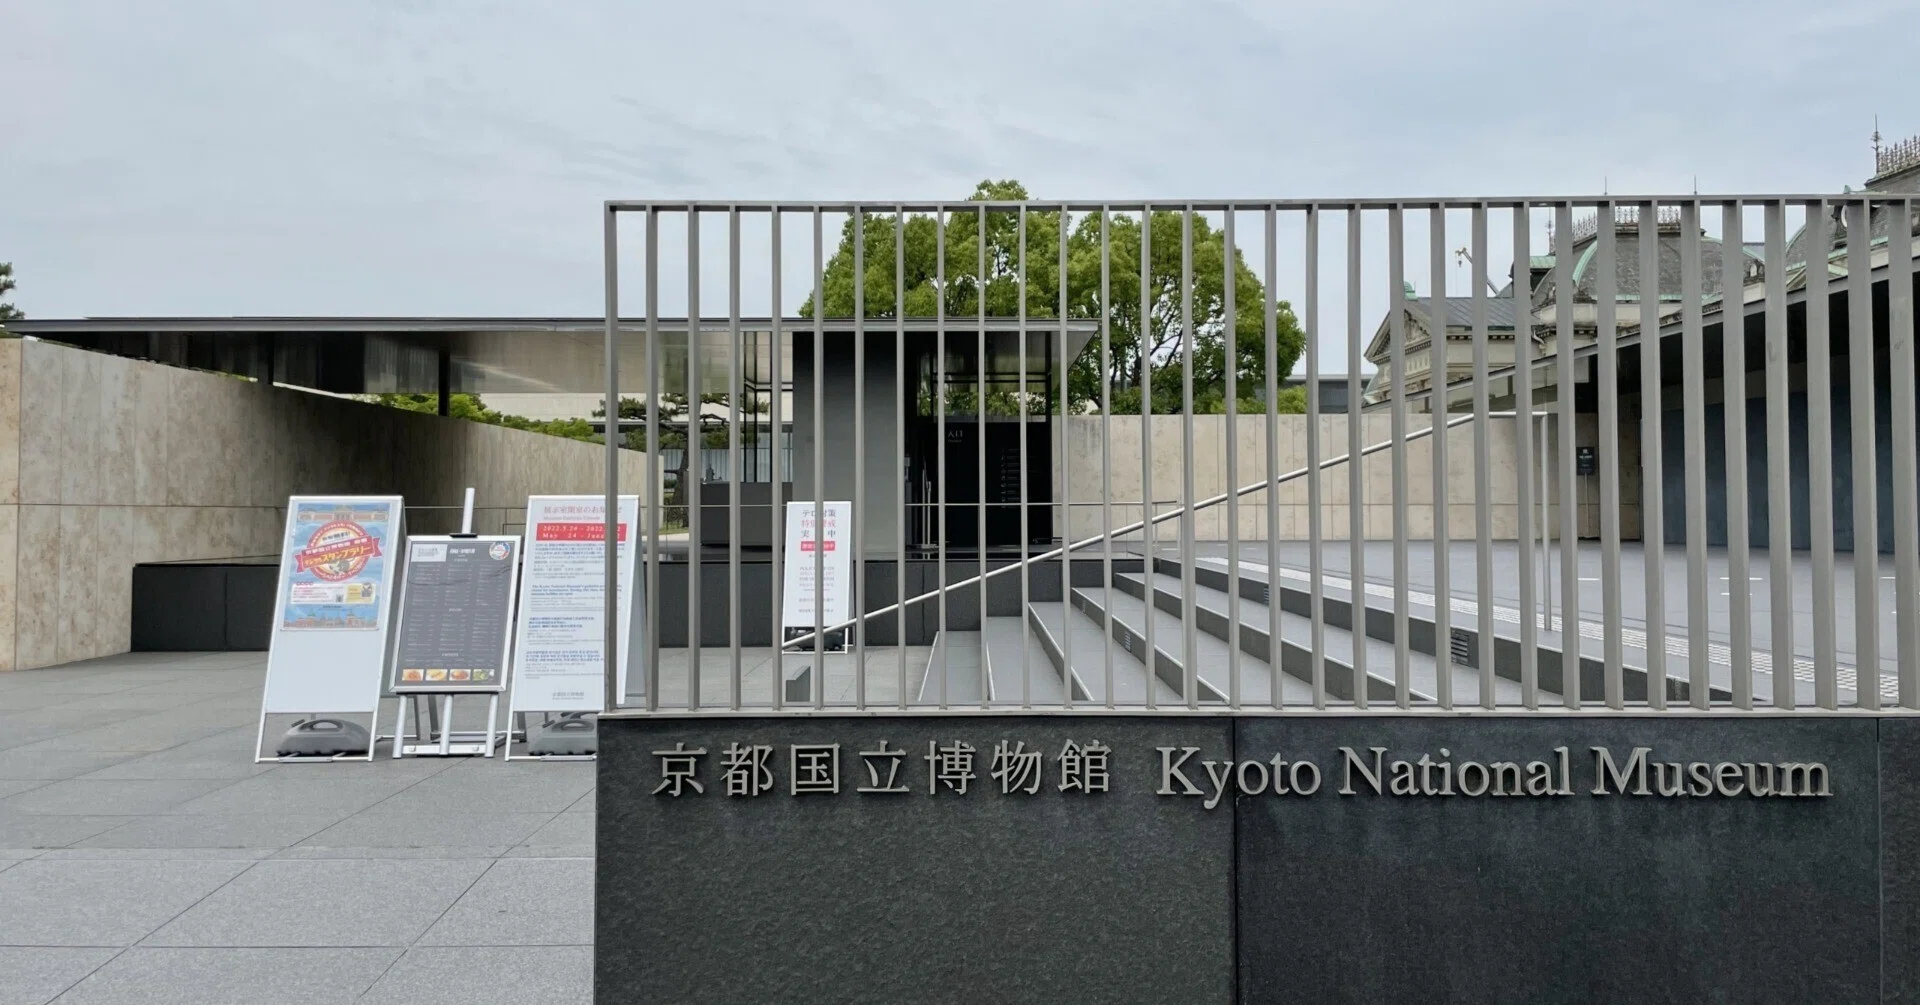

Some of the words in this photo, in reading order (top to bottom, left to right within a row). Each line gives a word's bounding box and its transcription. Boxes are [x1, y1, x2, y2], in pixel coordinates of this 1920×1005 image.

[651, 739, 1111, 796] 京都国立博物館
[1155, 746, 1322, 809] Kyoto
[1337, 746, 1575, 796] National
[1590, 746, 1833, 796] Museum
